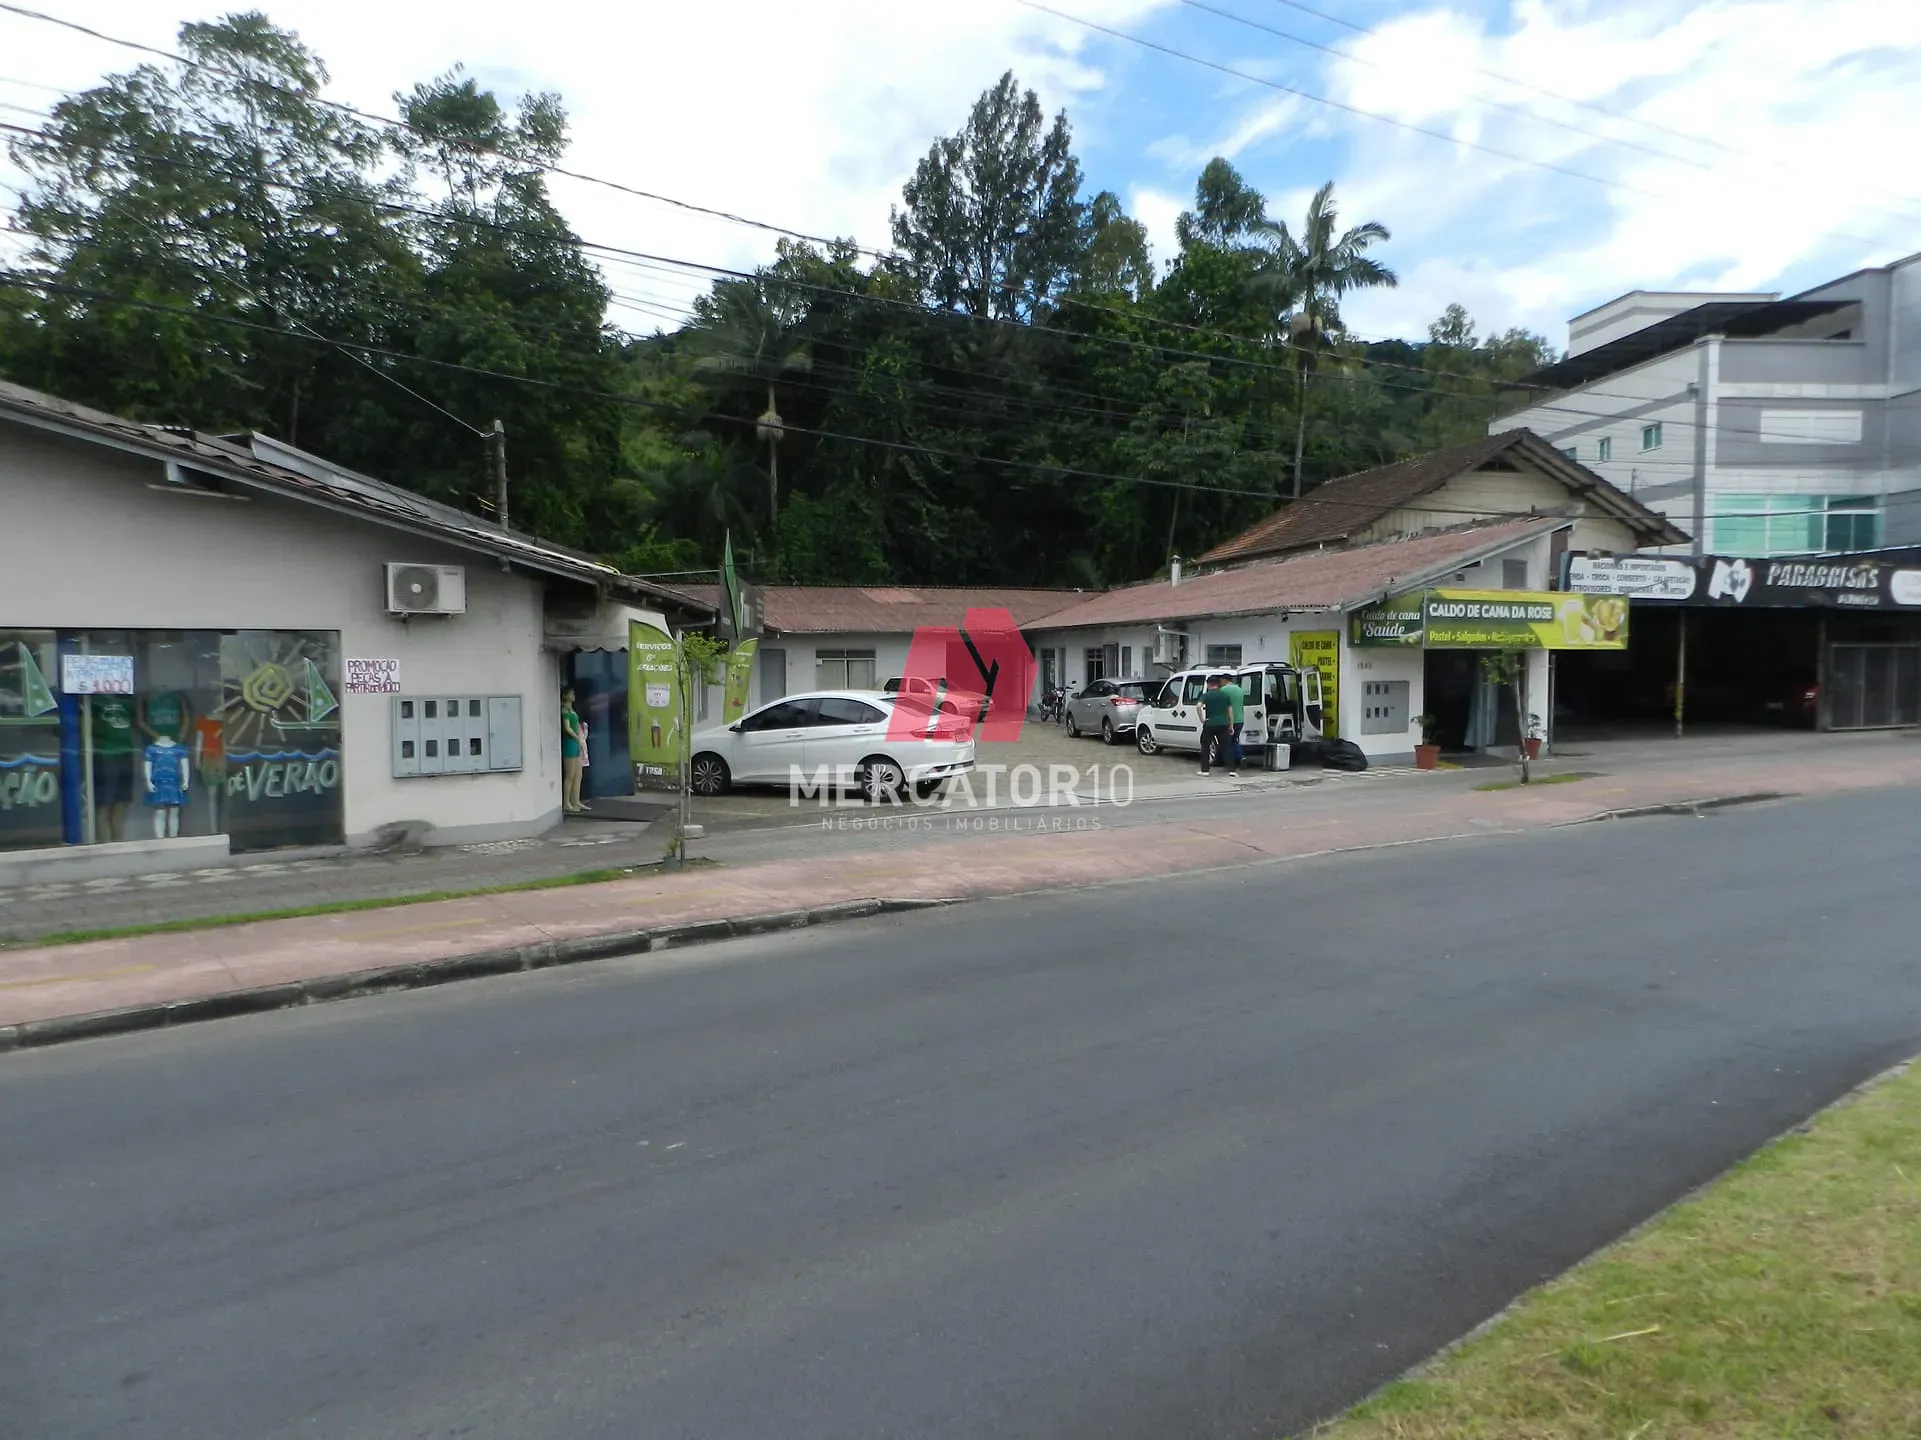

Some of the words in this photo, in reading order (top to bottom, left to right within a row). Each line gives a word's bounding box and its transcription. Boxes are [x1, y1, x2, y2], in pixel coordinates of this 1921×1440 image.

[1387, 610, 1397, 620] de
[1398, 612, 1421, 621] cana
[1429, 603, 1465, 618] CALDO
[1467, 604, 1480, 619] DE
[1482, 604, 1510, 620] CANA
[1512, 605, 1526, 620] DA
[1528, 606, 1553, 621] ROSE
[1366, 621, 1406, 638] Saúde
